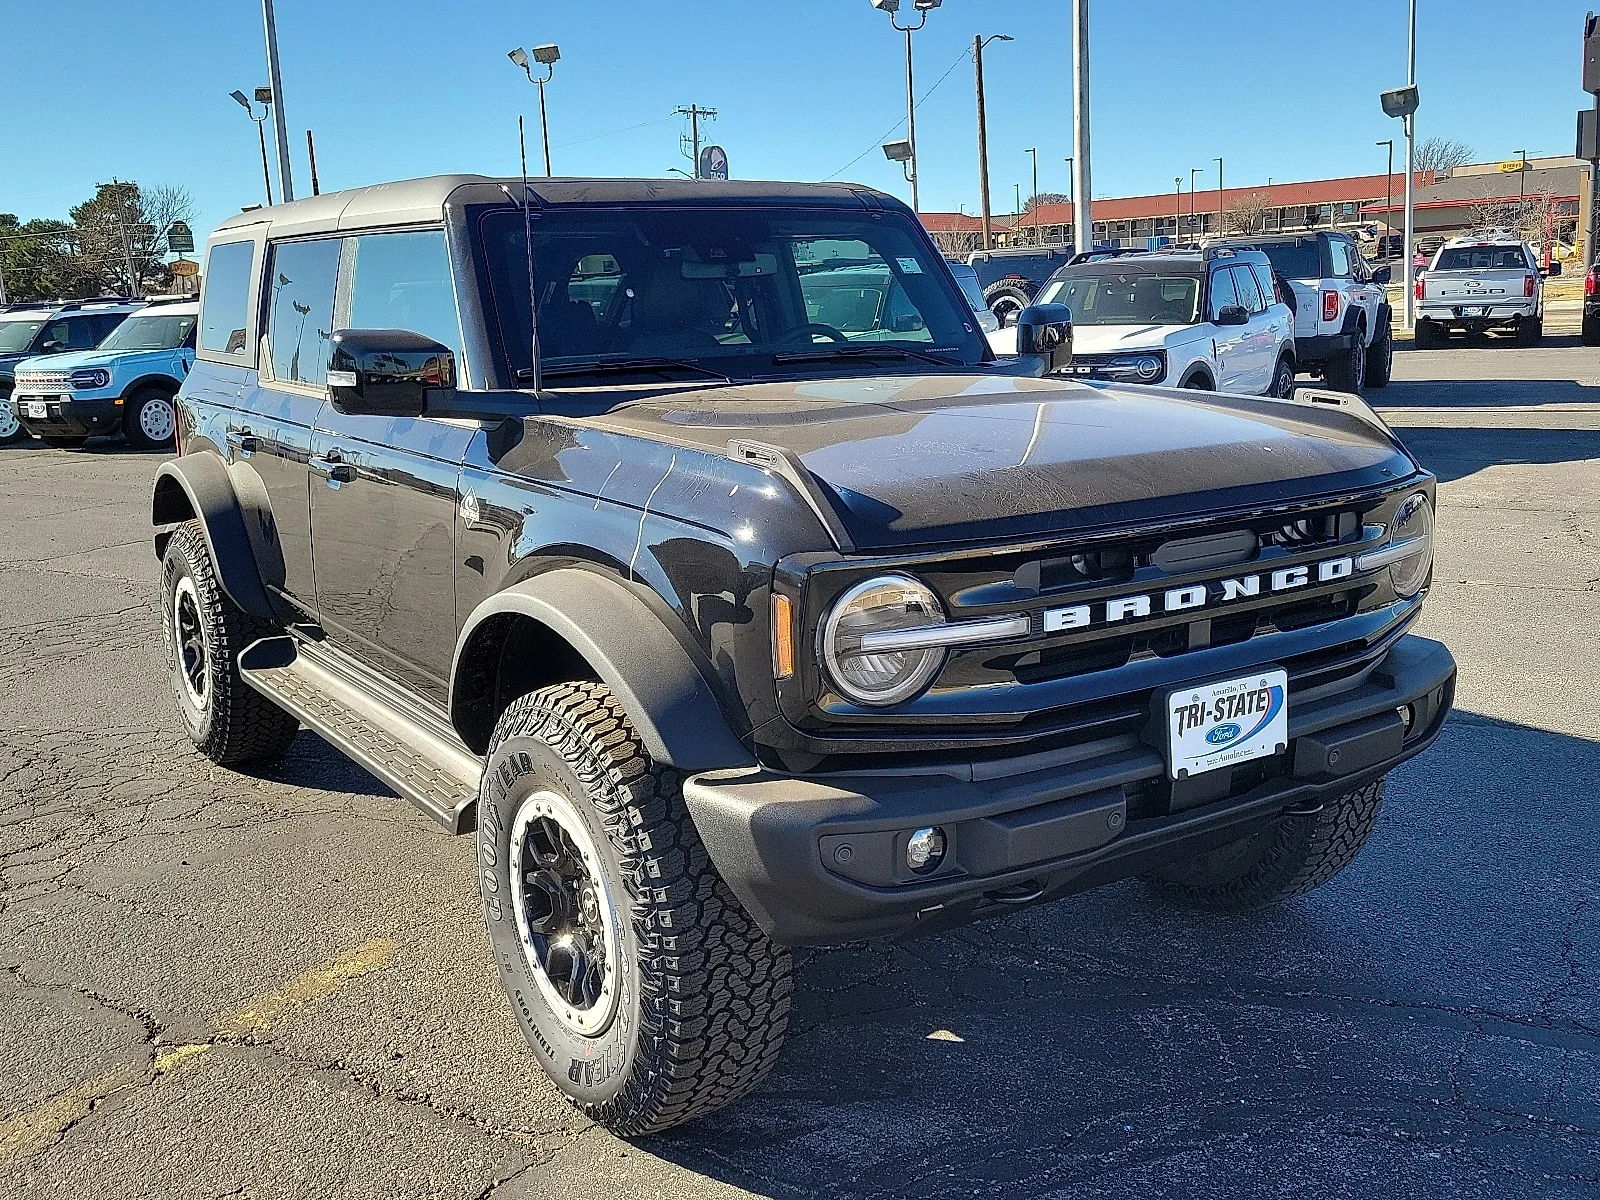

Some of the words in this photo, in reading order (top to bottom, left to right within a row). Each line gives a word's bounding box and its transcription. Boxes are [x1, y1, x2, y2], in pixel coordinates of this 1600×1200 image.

[709, 171, 726, 180] TACO
[1441, 288, 1507, 296] F-150
[1043, 557, 1353, 632] BRONCO
[1174, 687, 1268, 738] TRI-STATE
[1212, 726, 1234, 742] Ford
[513, 988, 557, 1061] TERRITORY
